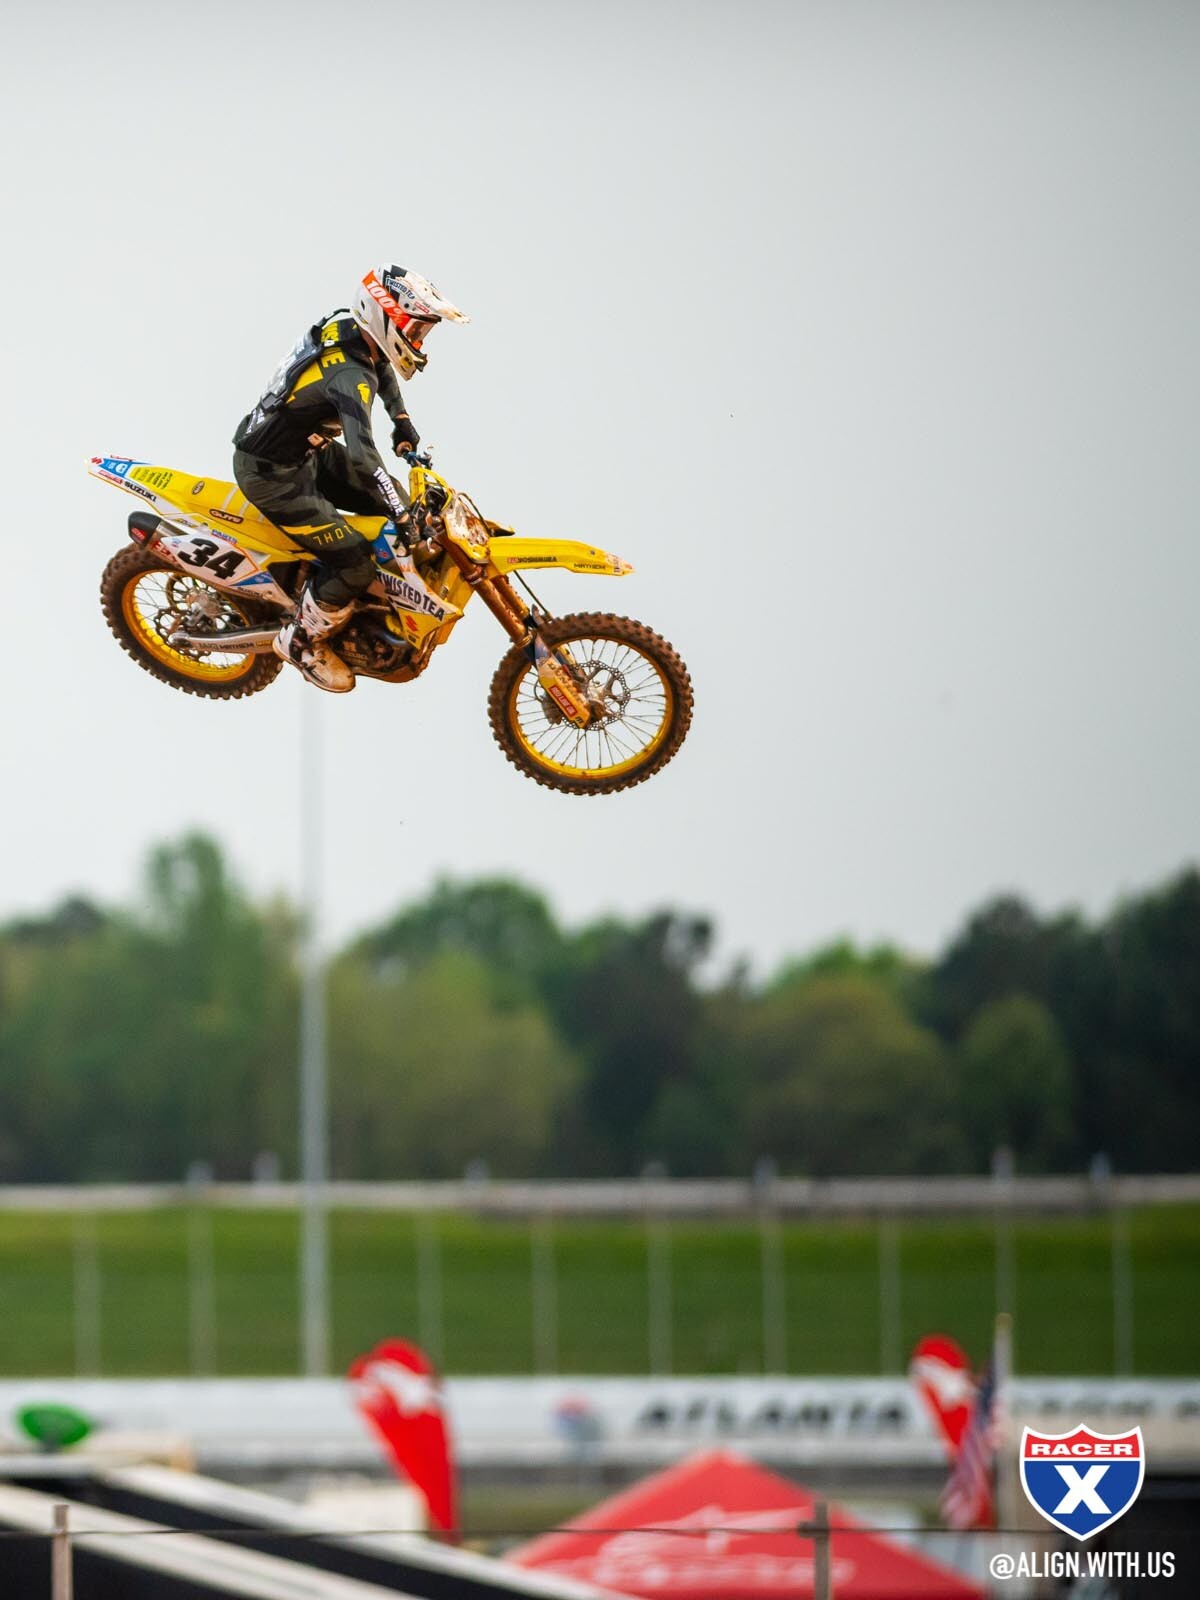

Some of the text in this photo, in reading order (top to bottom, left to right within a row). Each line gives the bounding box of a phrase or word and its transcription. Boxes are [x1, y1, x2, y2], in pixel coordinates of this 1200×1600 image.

[125, 480, 157, 503] SUZUKI
[373, 466, 400, 509] TWISTED
[177, 538, 246, 580] 34
[376, 571, 445, 622] TWISTED TEA
